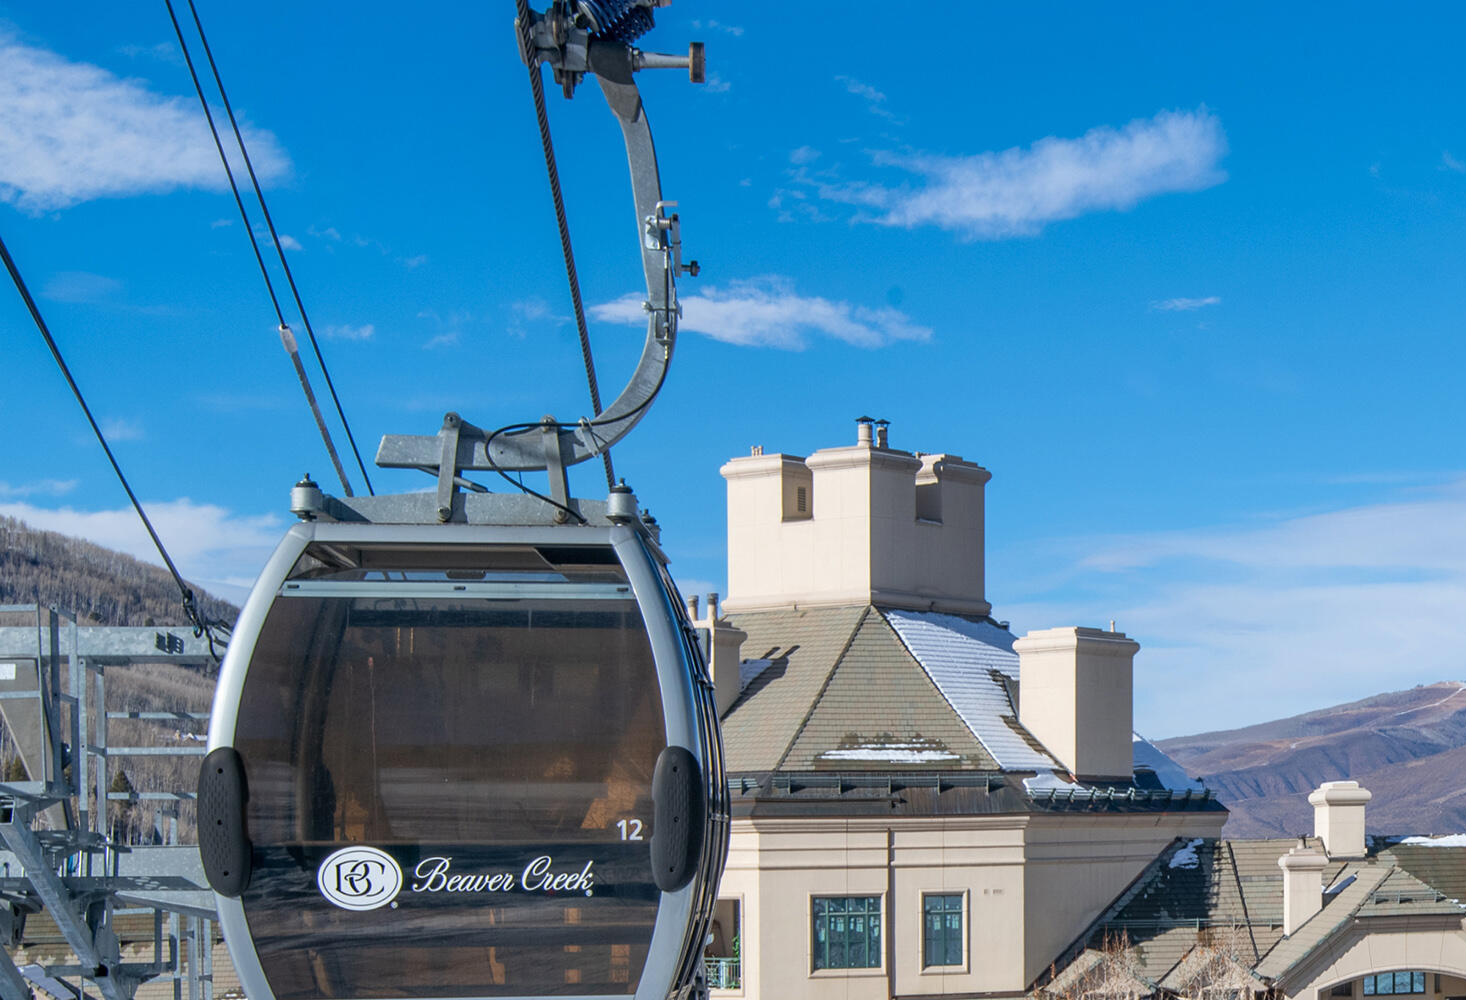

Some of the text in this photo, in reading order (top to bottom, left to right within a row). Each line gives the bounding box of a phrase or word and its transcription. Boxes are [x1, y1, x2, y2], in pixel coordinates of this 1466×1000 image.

[616, 818, 644, 841] 12
[335, 860, 385, 897] BC
[412, 855, 594, 892] Beaver Creek
